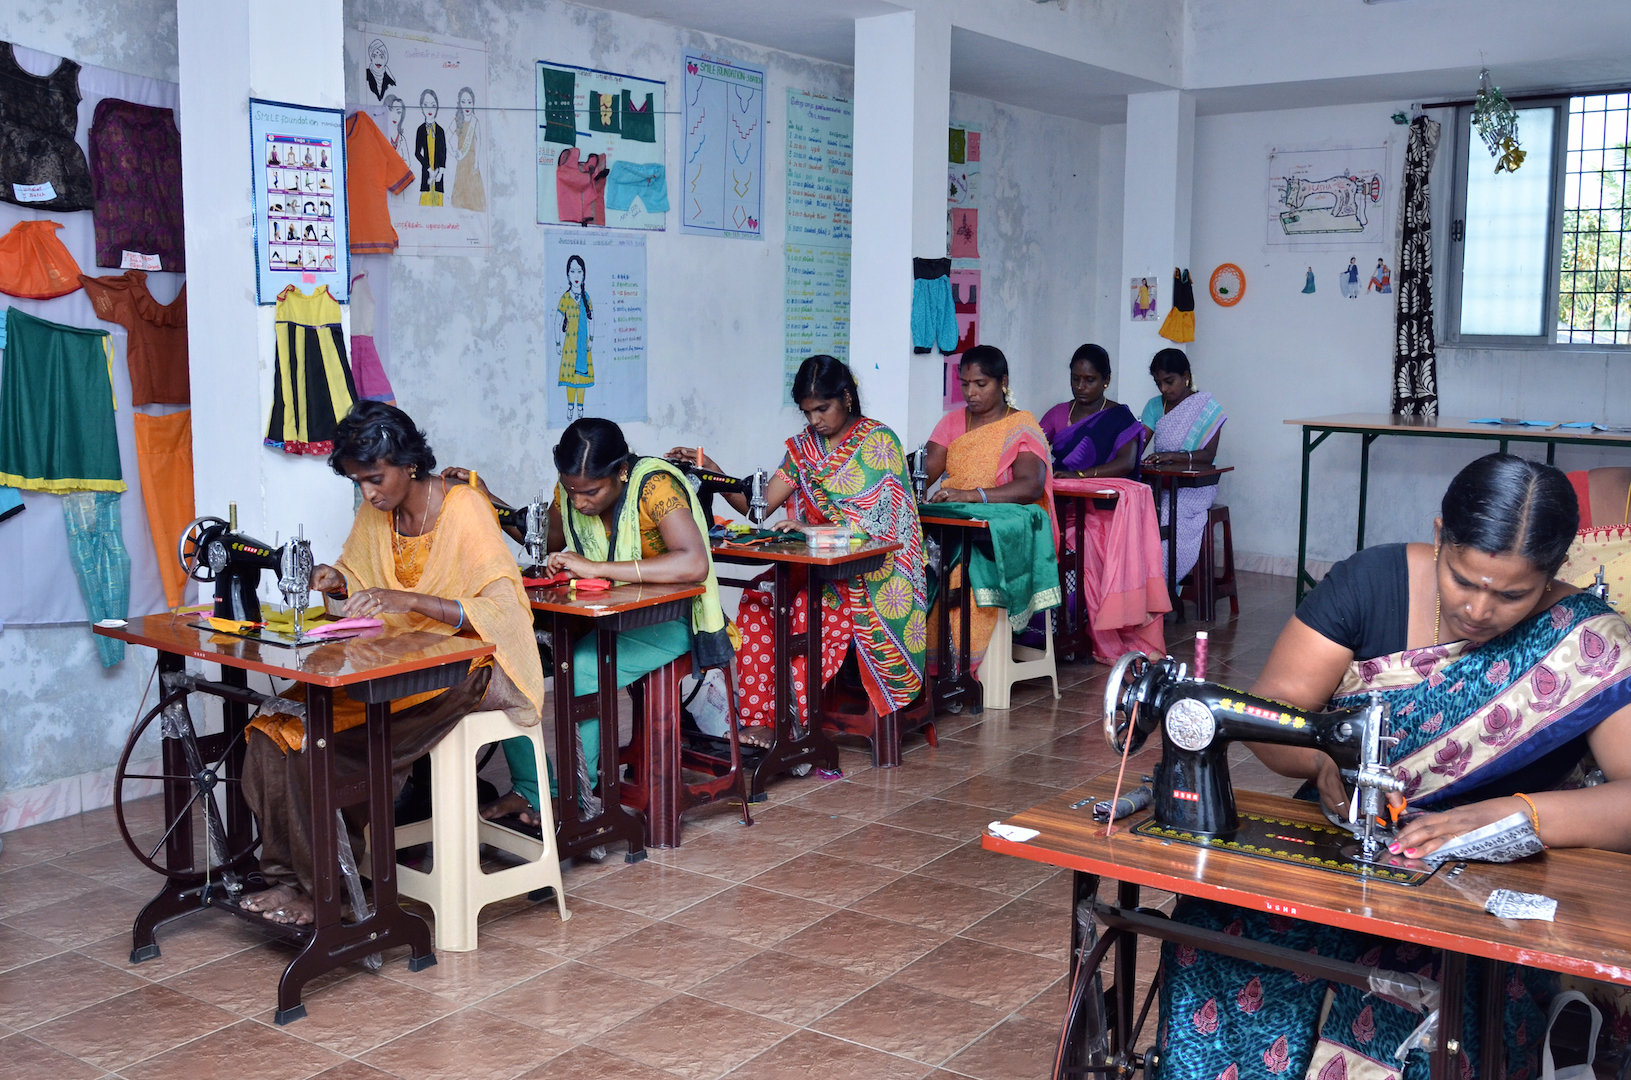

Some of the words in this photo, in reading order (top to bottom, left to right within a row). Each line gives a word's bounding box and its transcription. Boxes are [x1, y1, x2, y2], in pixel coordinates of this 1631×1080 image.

[700, 62, 716, 74] SMILE
[255, 111, 279, 122] SMILE
[281, 115, 318, 126] foundation
[1247, 706, 1278, 720] USHA
[1173, 791, 1198, 800] USHA
[1266, 902, 1297, 914] USHA
